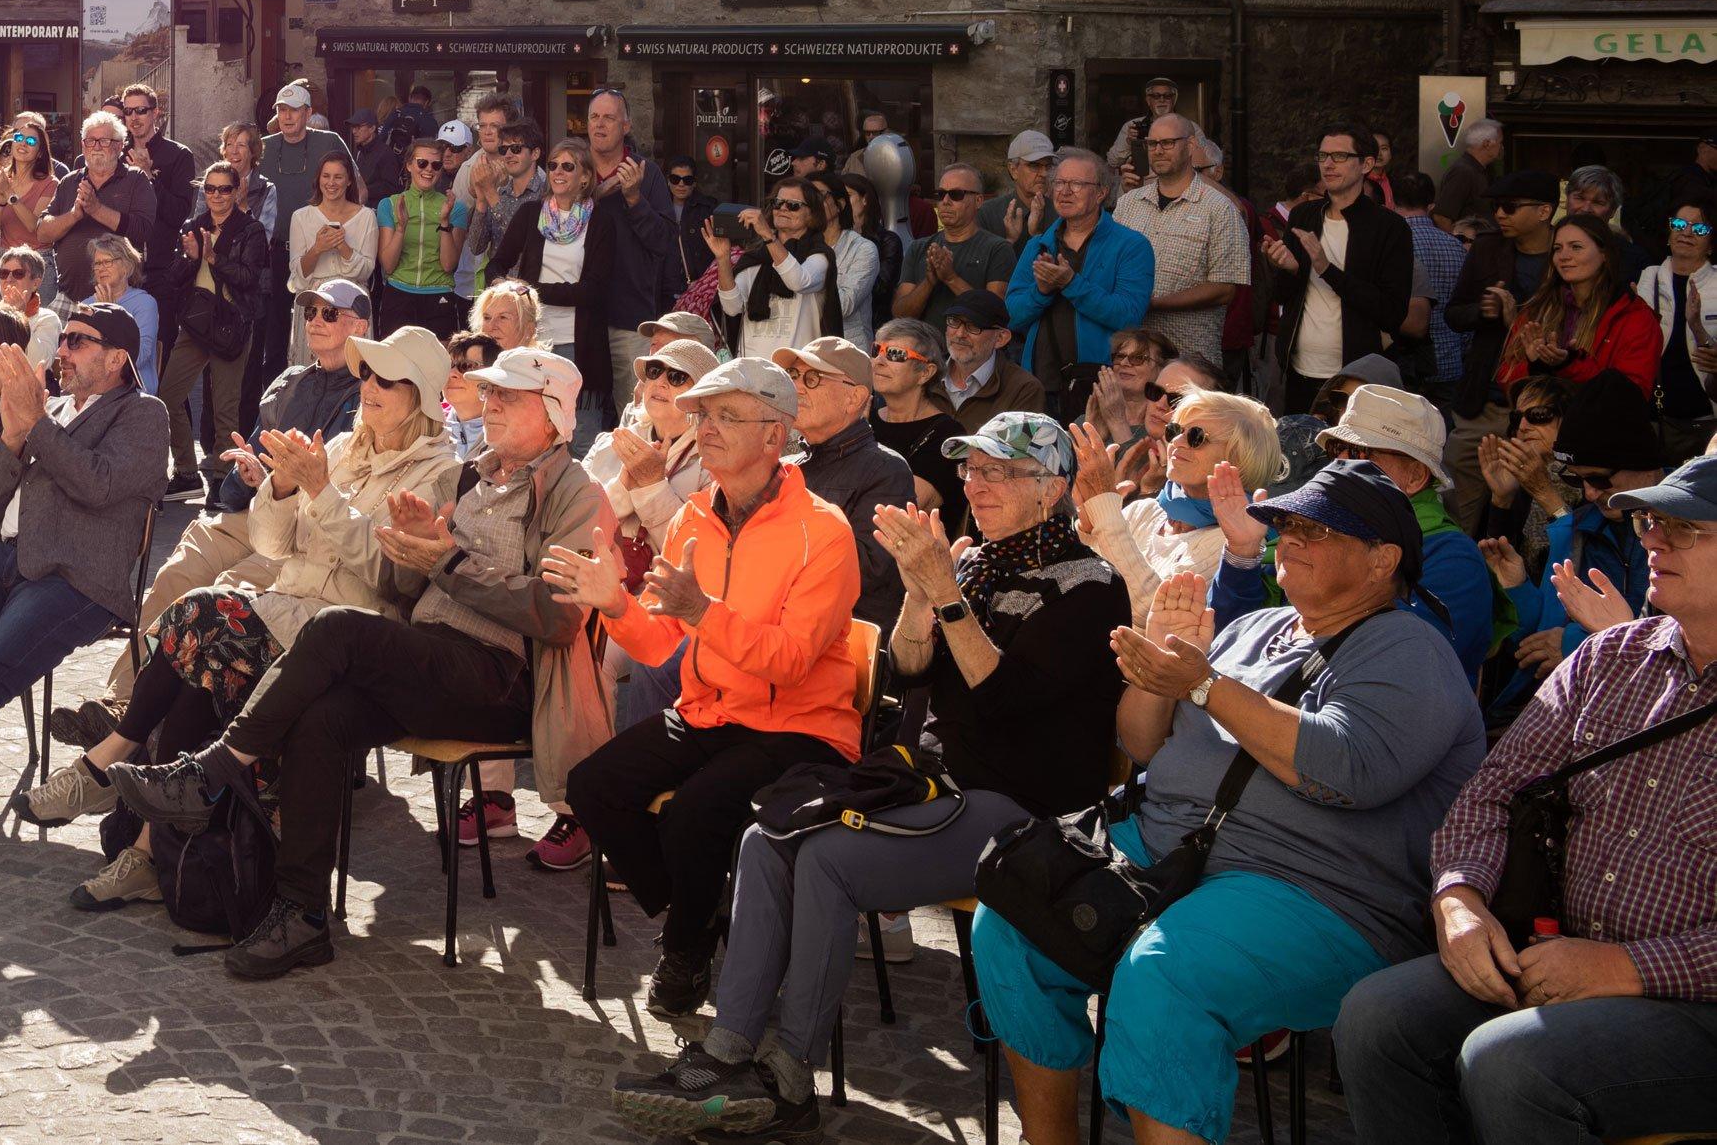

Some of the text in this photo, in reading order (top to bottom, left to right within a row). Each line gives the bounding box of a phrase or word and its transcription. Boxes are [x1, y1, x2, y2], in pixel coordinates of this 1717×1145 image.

[66, 25, 79, 38] AR
[332, 42, 430, 53] SWISS NATURAL PRODUCTS
[449, 42, 566, 54] SCHWEIZER NATURPRODUKTE
[637, 43, 764, 55] SWISS NATURAL PRODUCTS
[784, 43, 943, 56] SCHWEIZER NATURPRODUKTE
[696, 111, 738, 127] puralpina
